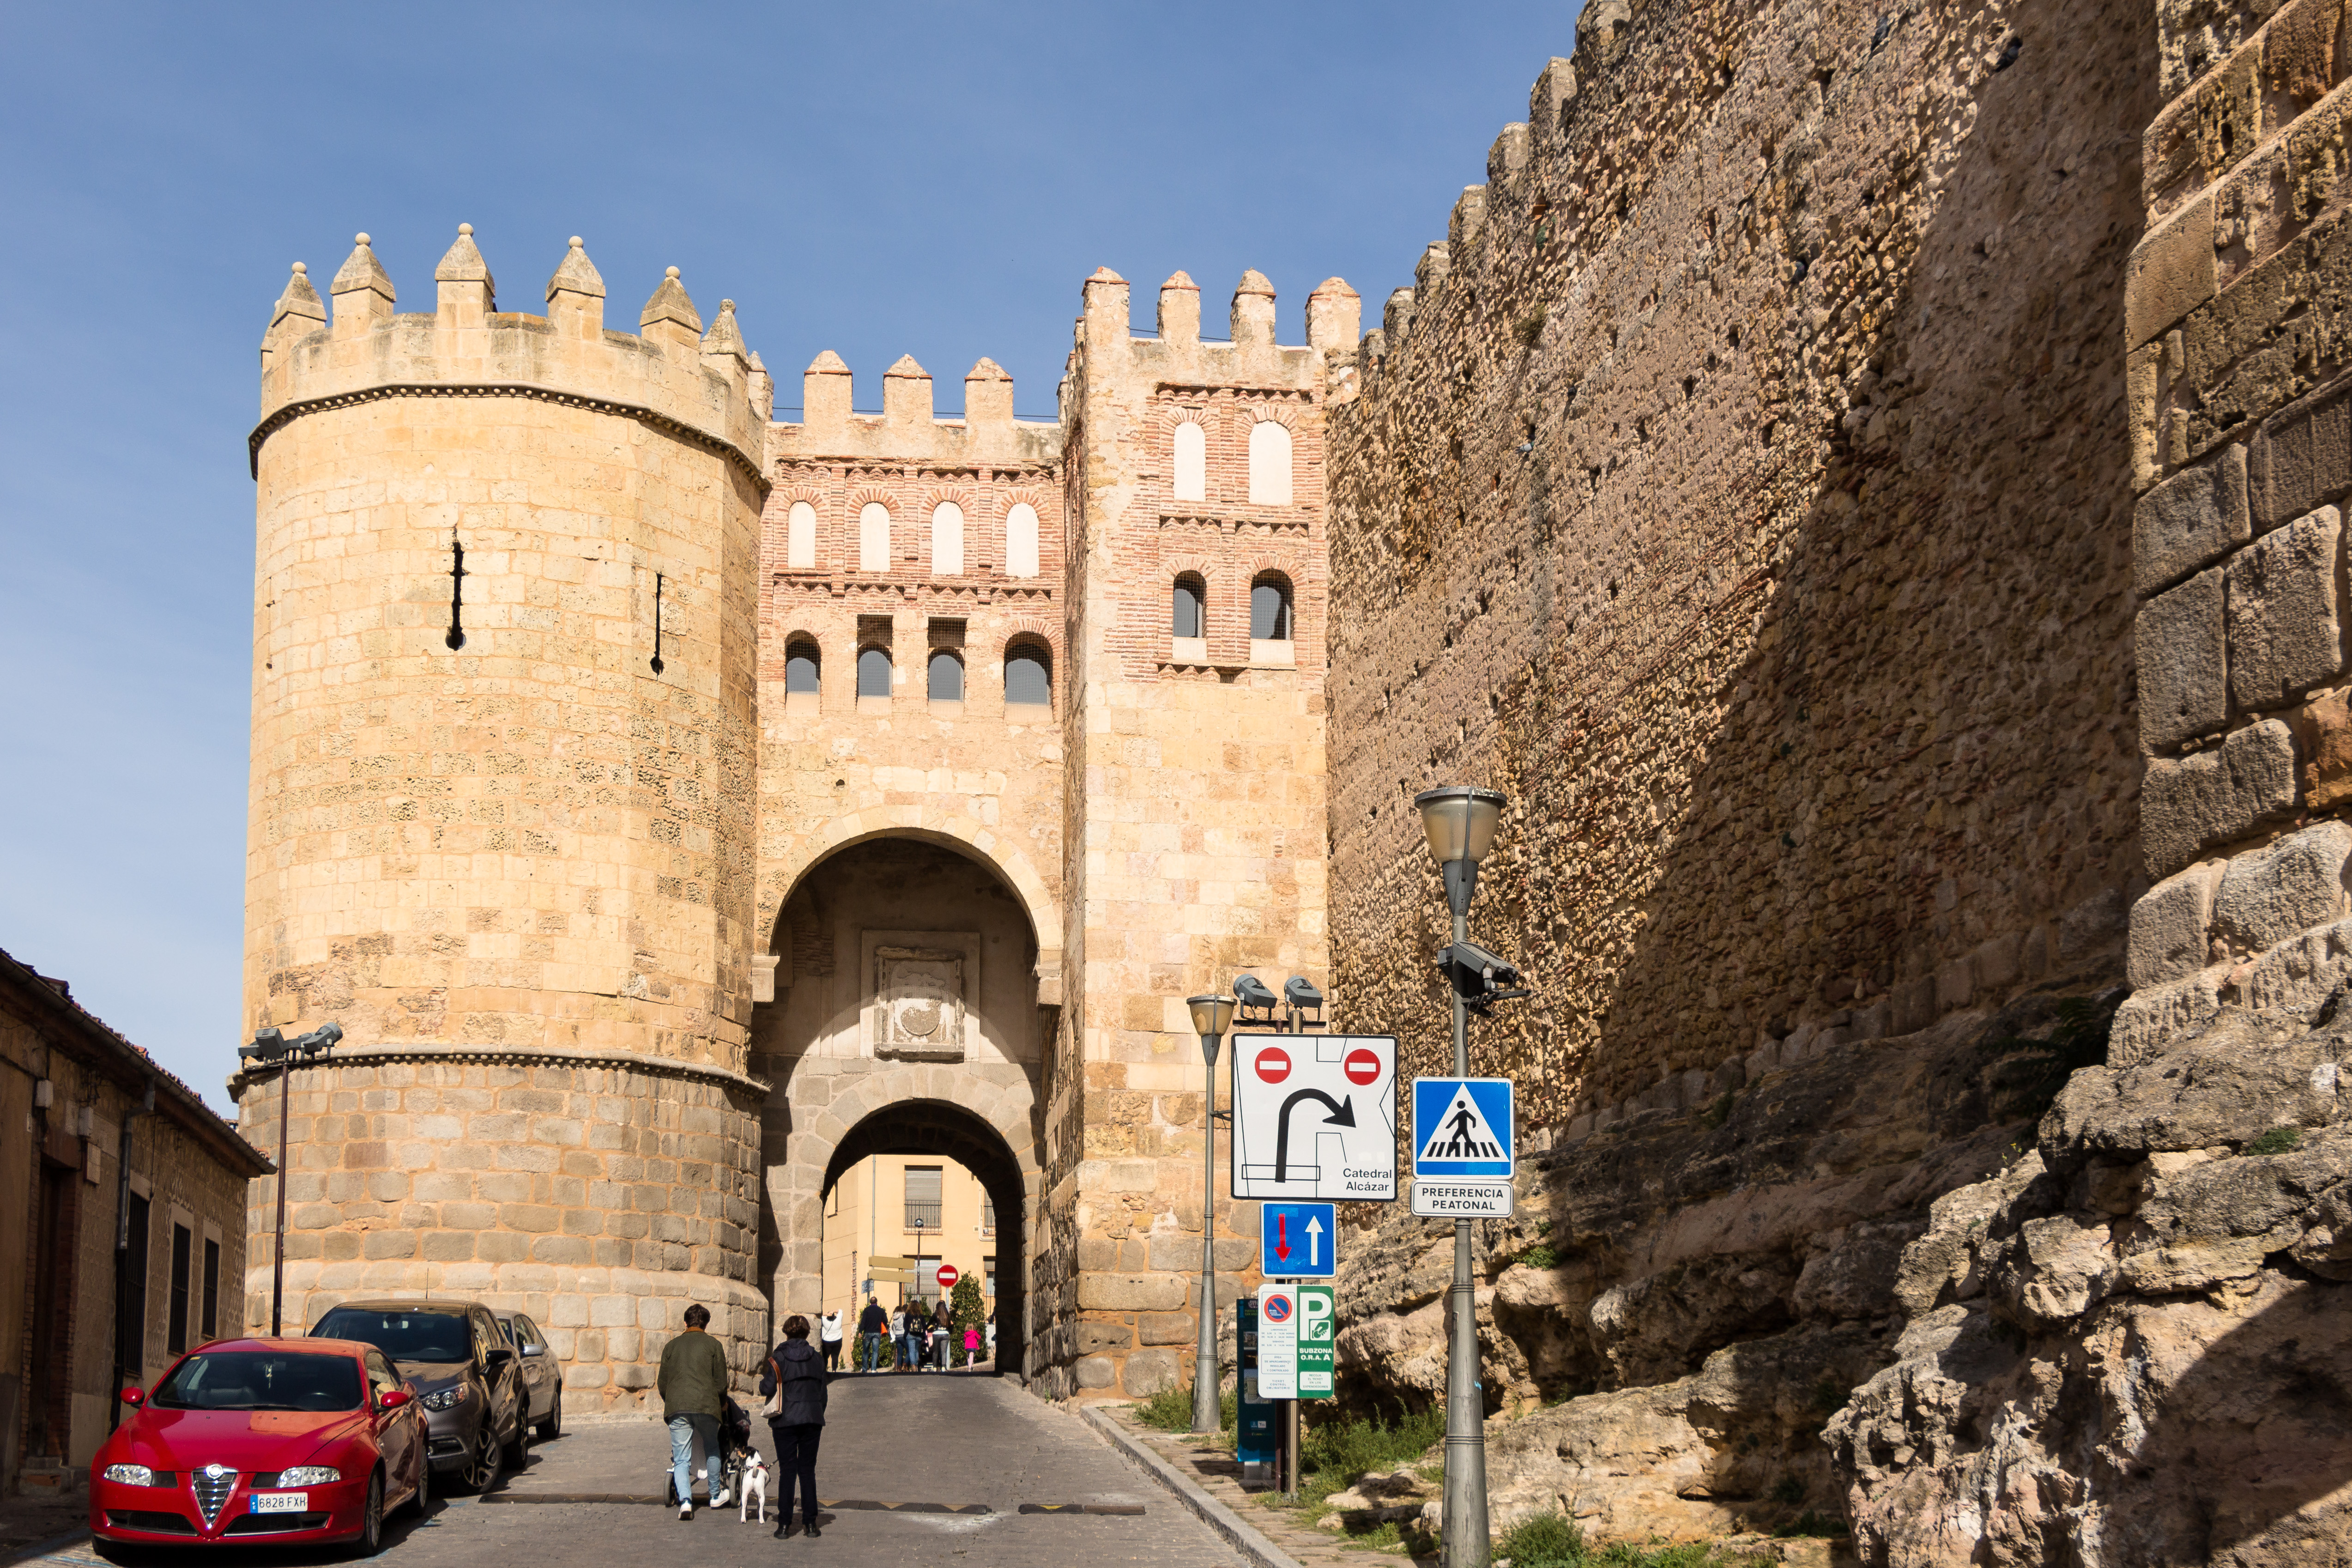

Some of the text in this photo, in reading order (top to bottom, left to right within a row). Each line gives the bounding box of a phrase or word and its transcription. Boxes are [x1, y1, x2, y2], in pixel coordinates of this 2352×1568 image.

[1343, 1168, 1392, 1178] Catedral
[1346, 1181, 1389, 1191] Alcázar
[1422, 1187, 1504, 1198] PREFERENCIA
[1433, 1200, 1496, 1210] PEATONAL
[1300, 1292, 1332, 1341] P
[259, 1496, 306, 1508] 6828 FXH
